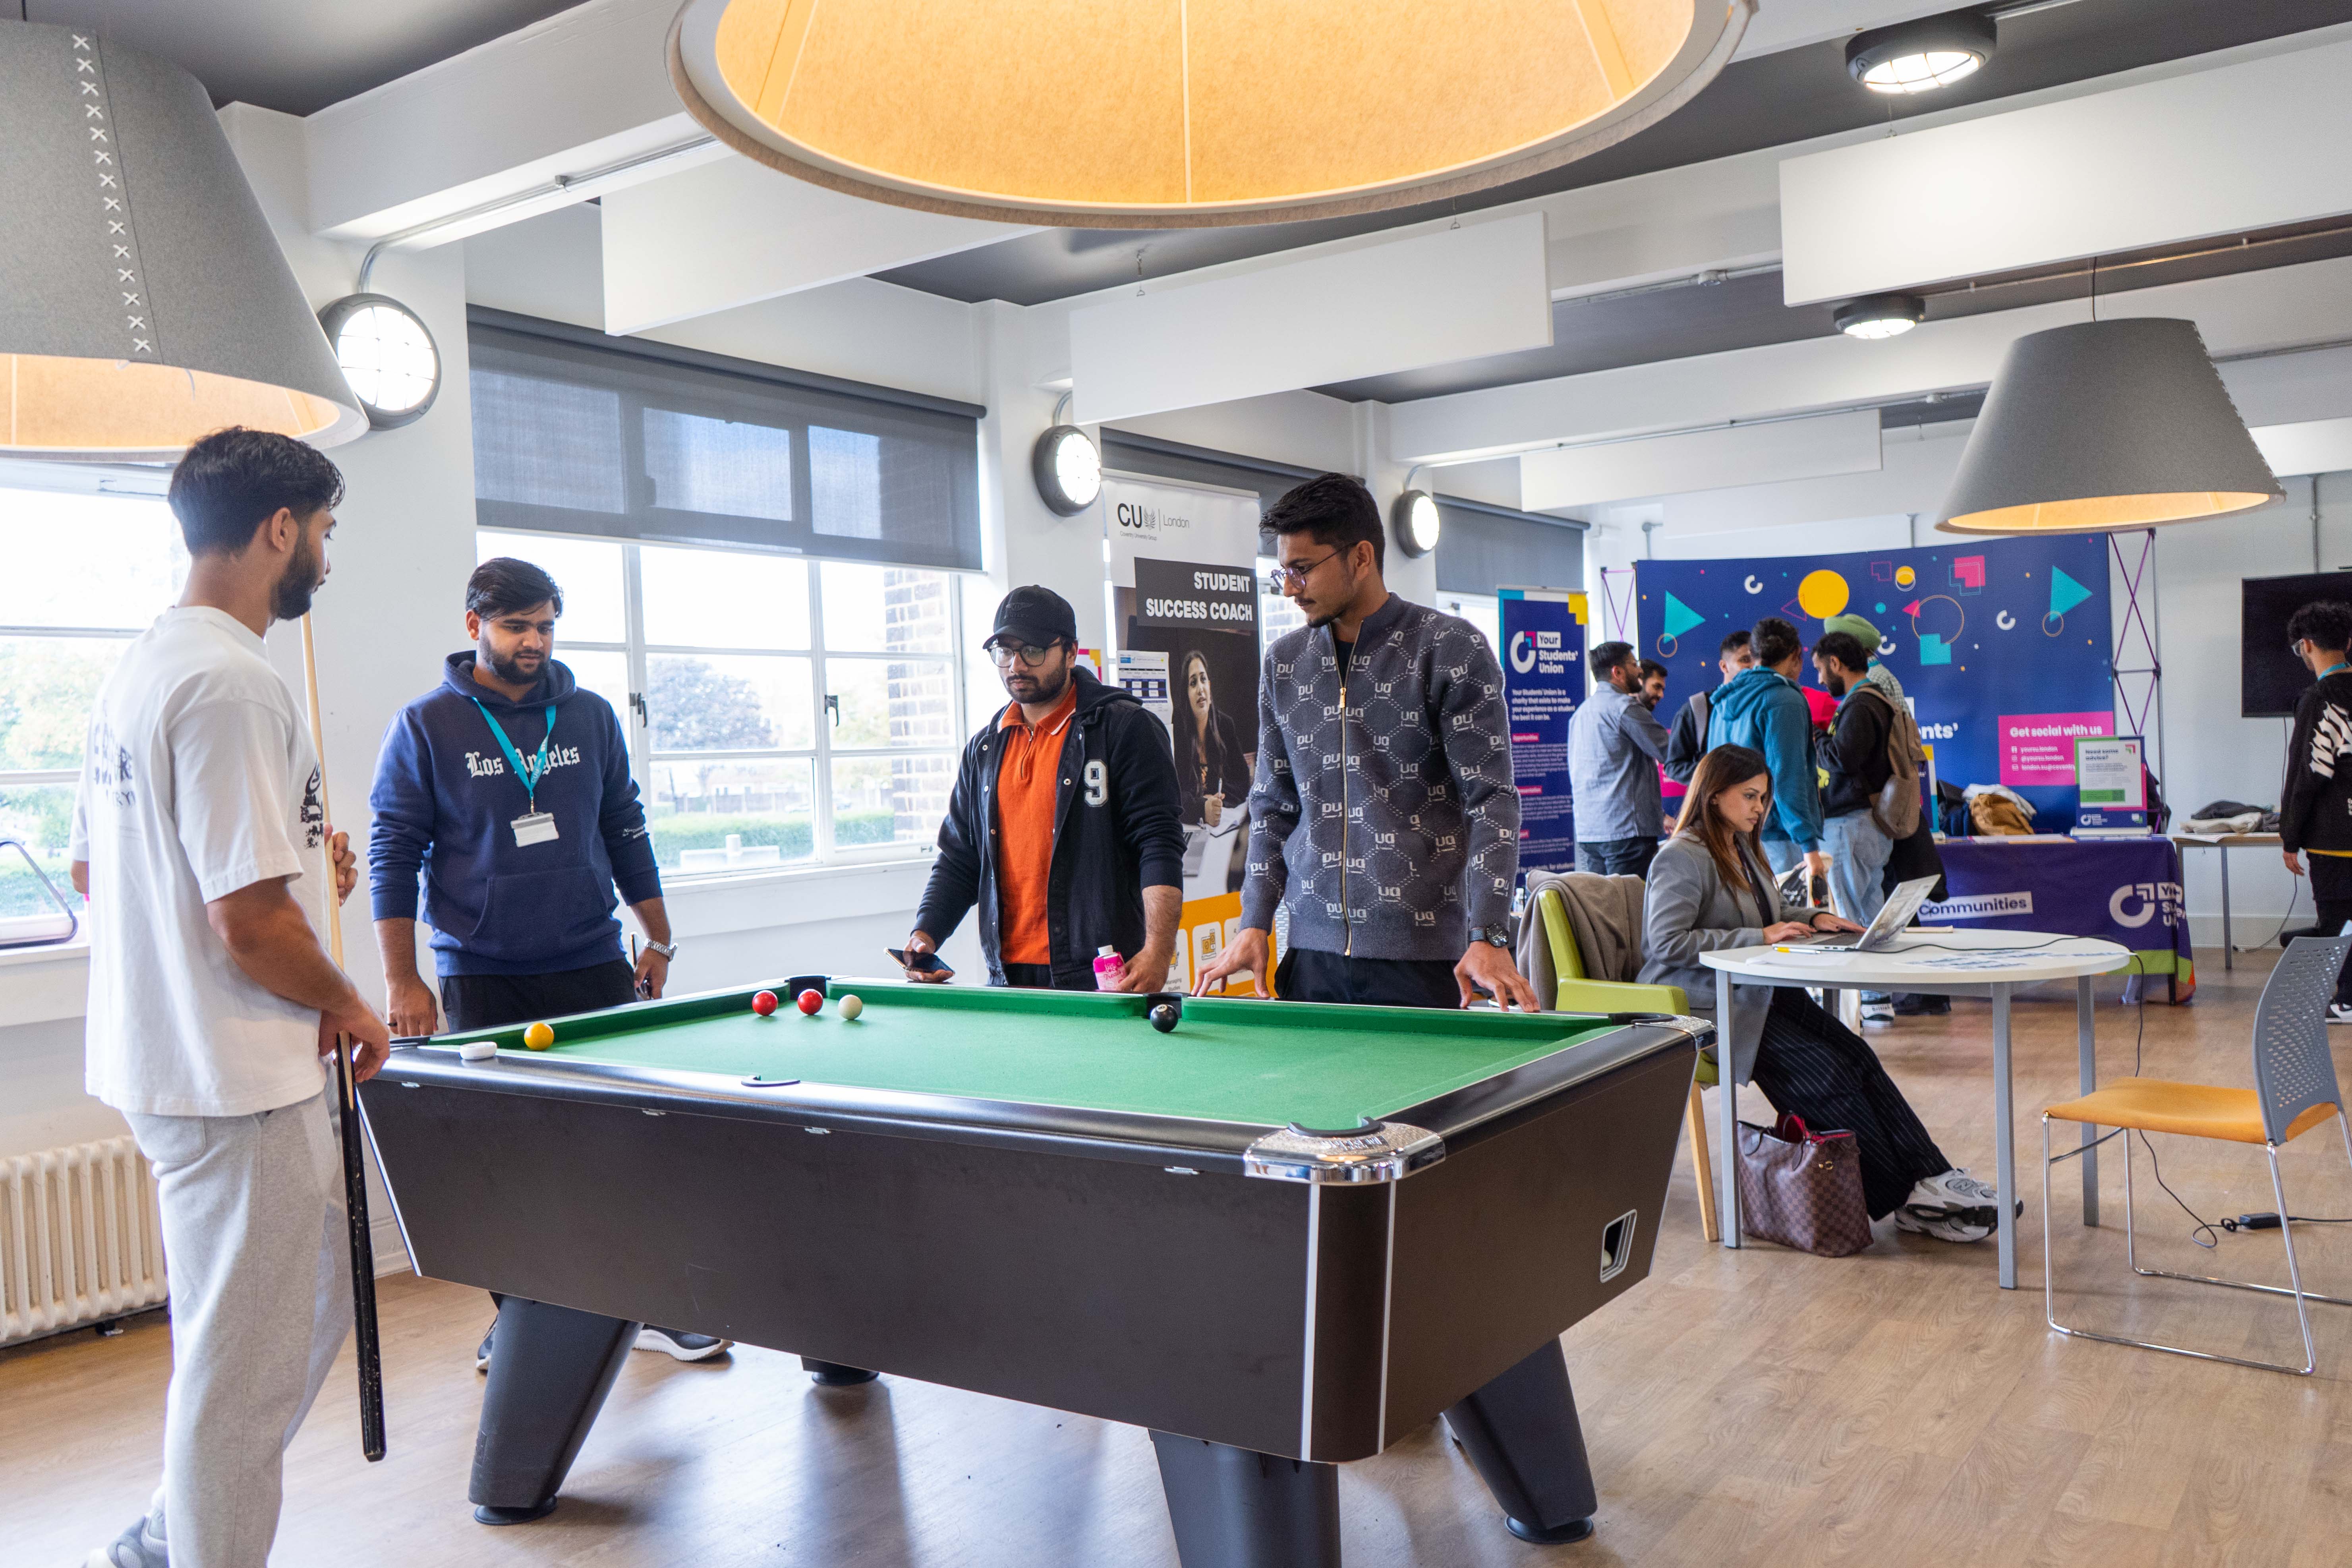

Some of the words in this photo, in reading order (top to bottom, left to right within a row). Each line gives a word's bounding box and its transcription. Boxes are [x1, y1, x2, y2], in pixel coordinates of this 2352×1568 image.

[1117, 503, 1142, 528] CU
[1163, 514, 1190, 528] London
[1194, 571, 1250, 593] STUDENT
[1146, 597, 1208, 619] SUCCESS
[1210, 601, 1253, 621] COACH
[1539, 635, 1559, 645] Your
[1538, 661, 1564, 674] Union
[2010, 727, 2030, 737] Get
[2031, 725, 2062, 737] social
[2063, 724, 2088, 736] with
[2089, 725, 2103, 735] us
[465, 751, 504, 778] Los
[1084, 759, 1108, 807] 9
